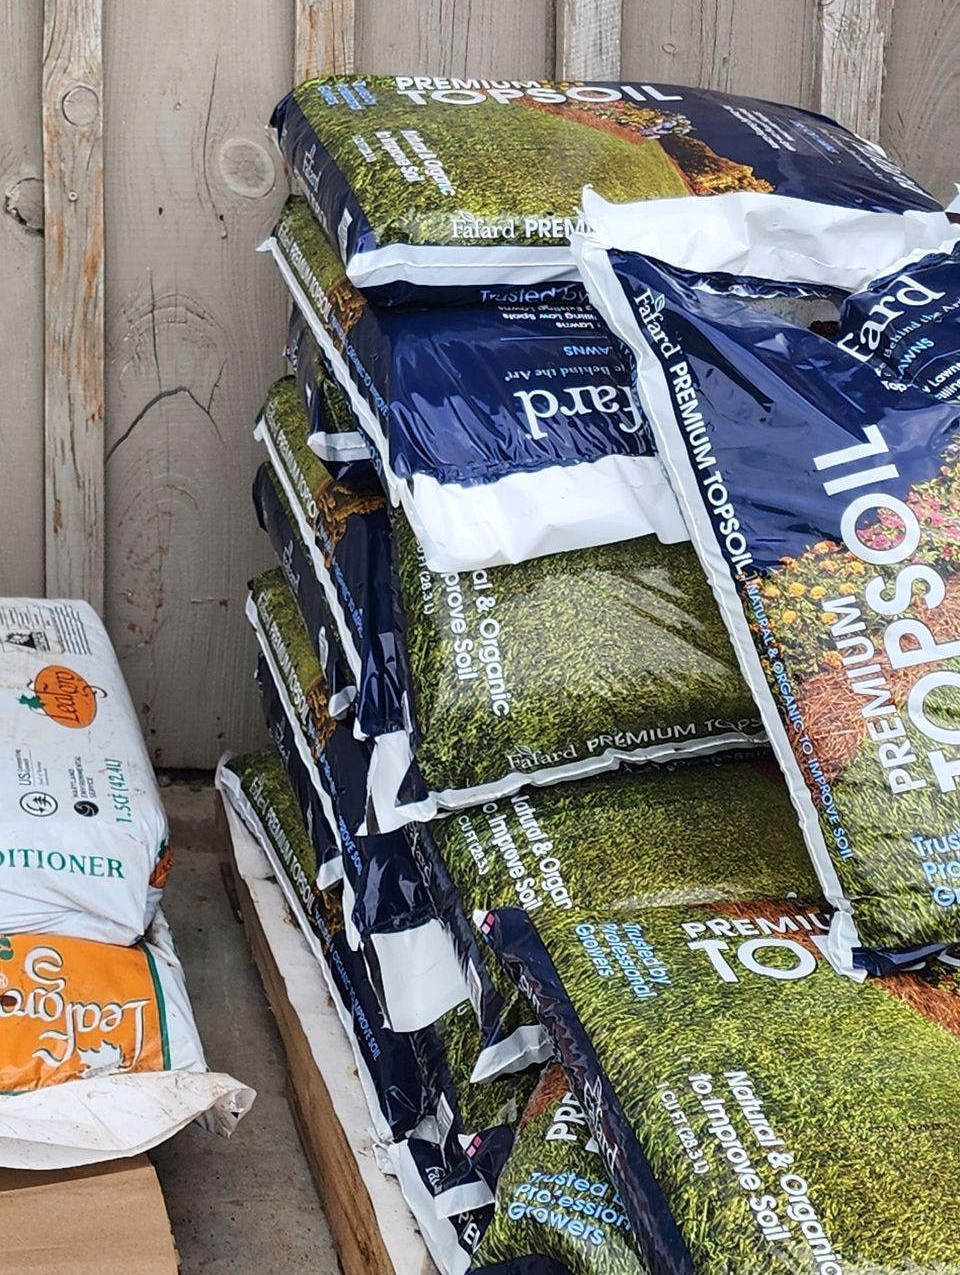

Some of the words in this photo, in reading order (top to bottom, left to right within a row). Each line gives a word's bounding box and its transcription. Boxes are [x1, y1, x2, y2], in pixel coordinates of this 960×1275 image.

[397, 85, 684, 105] TOPSOIL
[452, 216, 517, 239] Fafard
[561, 365, 610, 378] Behind
[563, 346, 613, 356] AWNS
[897, 337, 935, 380] AWNS
[634, 288, 680, 360] Fafard
[670, 361, 716, 470] PREMIUM
[704, 470, 754, 576] TOPSOIL
[746, 581, 776, 646] NATURAL
[767, 646, 778, 659] &
[773, 661, 805, 733] ORGANIC
[799, 733, 814, 756] TO
[807, 755, 841, 825] IMPROVE
[833, 825, 855, 863] SOIL
[475, 597, 496, 612] &
[813, 424, 960, 793] TOPSOIL
[454, 638, 478, 680] Soil
[478, 618, 510, 717] Organic
[27, 669, 107, 724] Leafgro
[822, 595, 927, 795] PREMIUM
[507, 744, 579, 771] Fafard
[586, 723, 697, 753] PREMIUM
[18, 772, 31, 785] US
[112, 793, 132, 823] 1.5CF
[265, 806, 294, 861] PREMIUM
[289, 852, 316, 915] TOPSOIL
[488, 814, 526, 879] Improve
[515, 877, 544, 911] Soil
[532, 840, 553, 857] &
[912, 826, 960, 858] Trus
[575, 923, 615, 978] Growers
[600, 923, 658, 1001] Professional
[623, 923, 660, 966] Trusted
[651, 962, 672, 986] by
[660, 1090, 681, 1112] CU
[688, 1073, 713, 1095] to
[670, 1110, 688, 1125] FT
[724, 1070, 785, 1147] Natural
[767, 1151, 794, 1170] &
[676, 1127, 704, 1160] (28.3
[700, 1098, 761, 1191] Improve
[529, 1171, 608, 1198] Trusted
[507, 1201, 605, 1245] Growers
[749, 1194, 792, 1242] Soil
